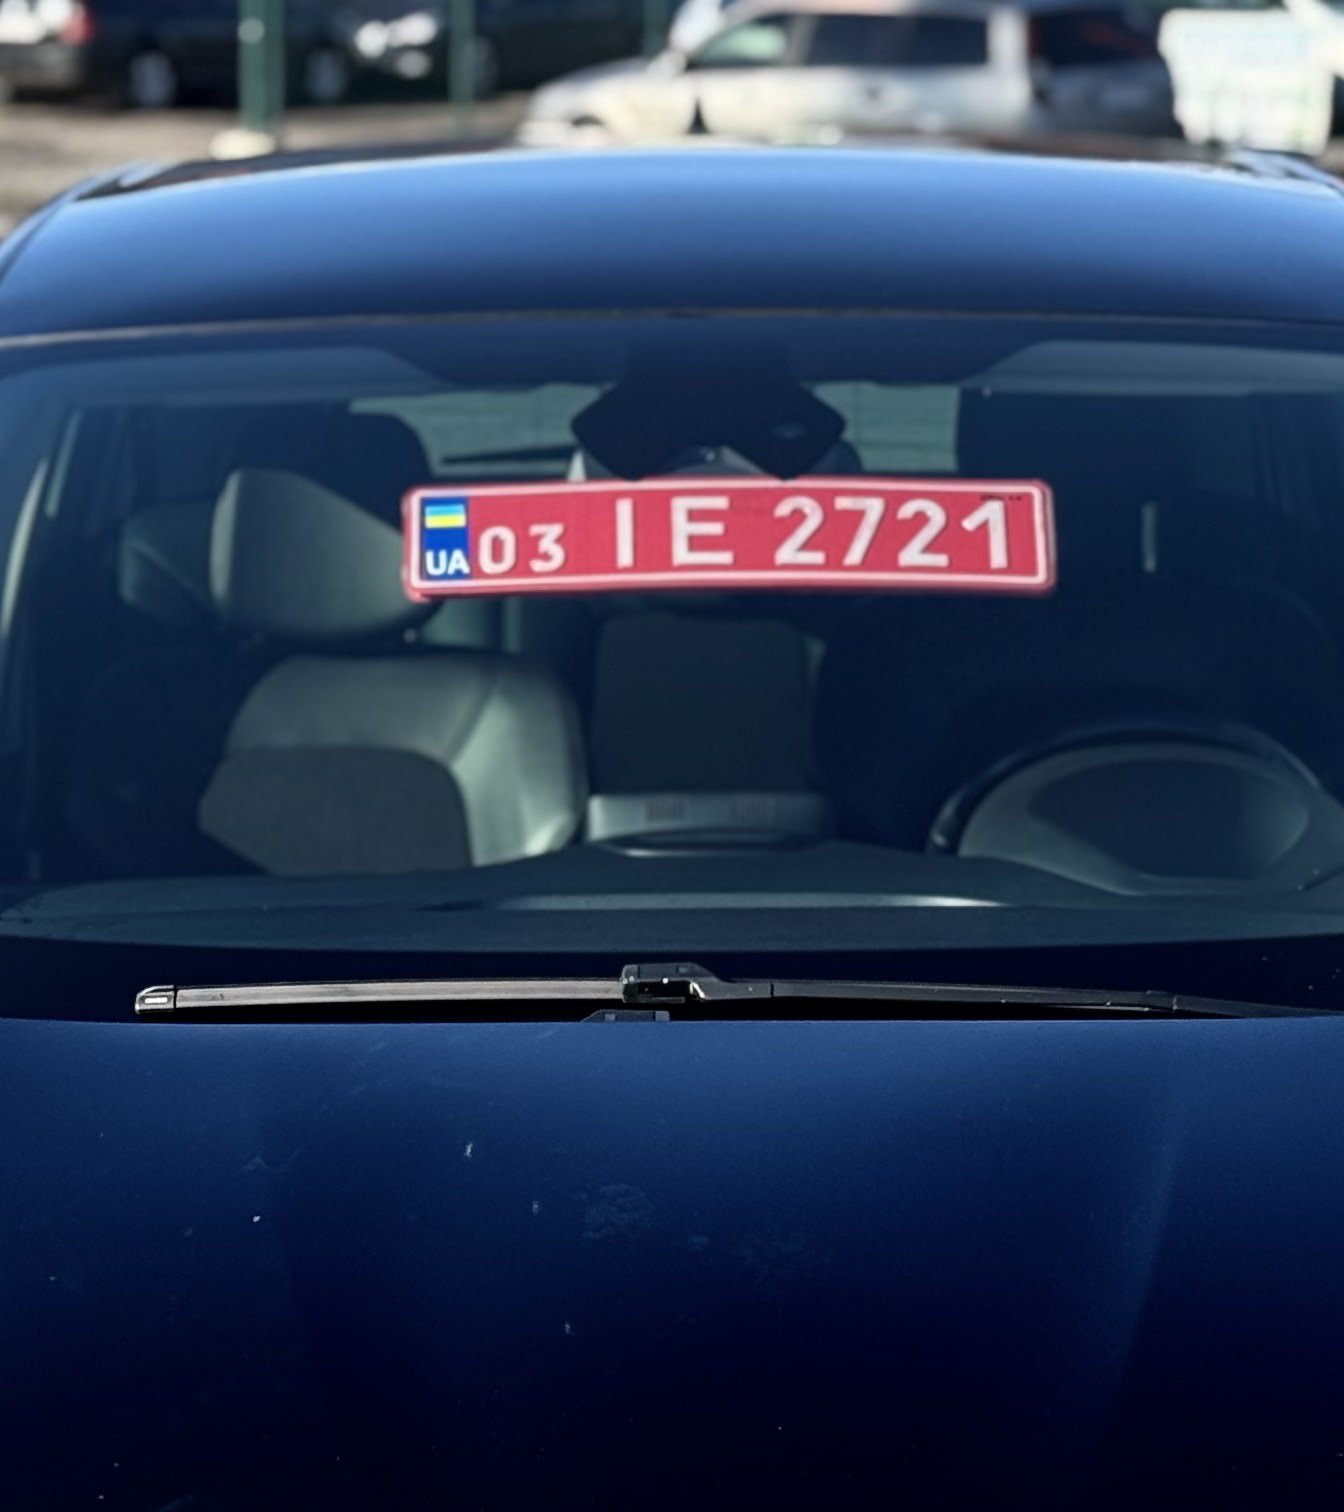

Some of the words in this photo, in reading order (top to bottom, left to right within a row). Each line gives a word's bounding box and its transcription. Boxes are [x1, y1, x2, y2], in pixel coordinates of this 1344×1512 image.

[478, 523, 566, 574] 03
[615, 496, 735, 568] IE
[773, 496, 1010, 569] 2721
[425, 549, 471, 576] UA
